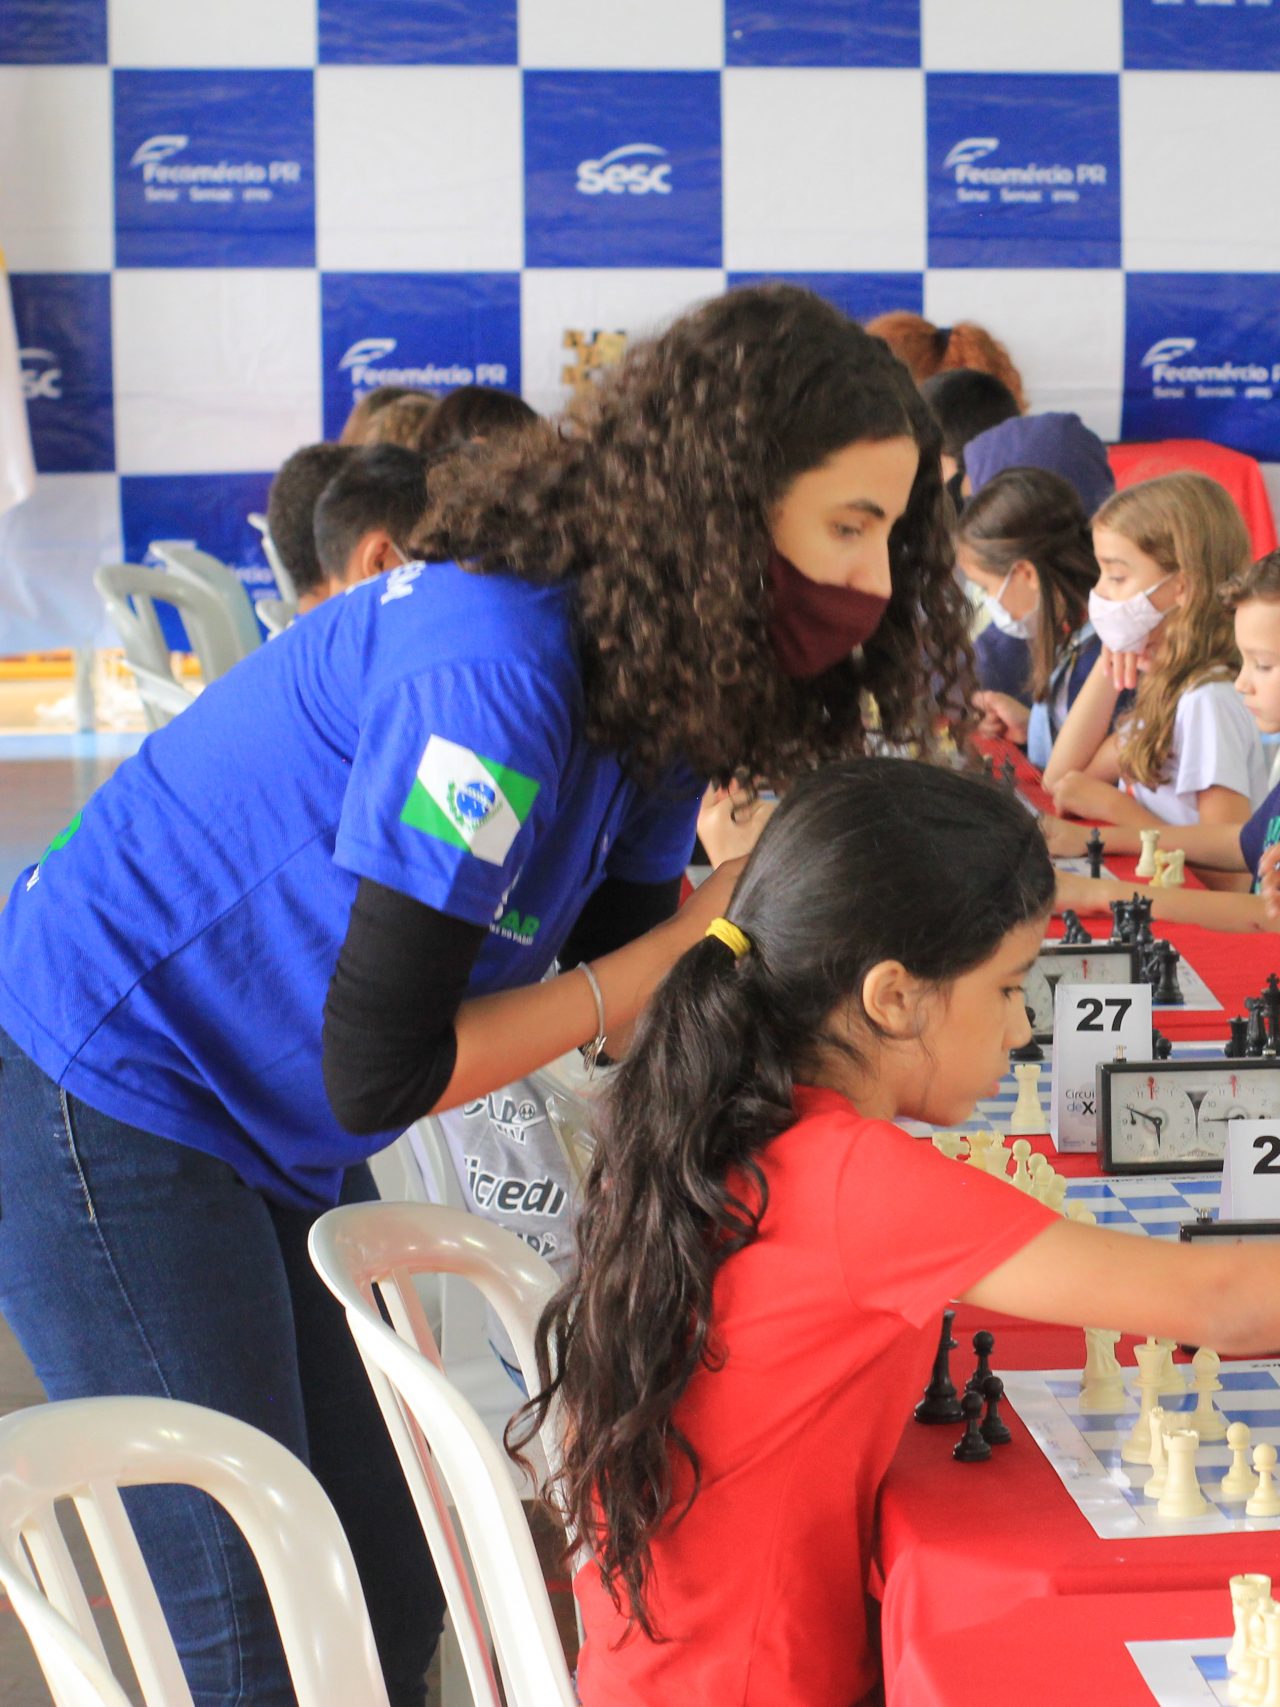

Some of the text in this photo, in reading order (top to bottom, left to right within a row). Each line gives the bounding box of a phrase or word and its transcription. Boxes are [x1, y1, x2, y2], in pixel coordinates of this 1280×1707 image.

[269, 161, 300, 184] PR
[577, 160, 673, 194] Sesc
[1076, 163, 1107, 185] PR
[475, 363, 507, 386] PR
[1076, 998, 1132, 1032] 27
[1066, 1089, 1095, 1099] Circui
